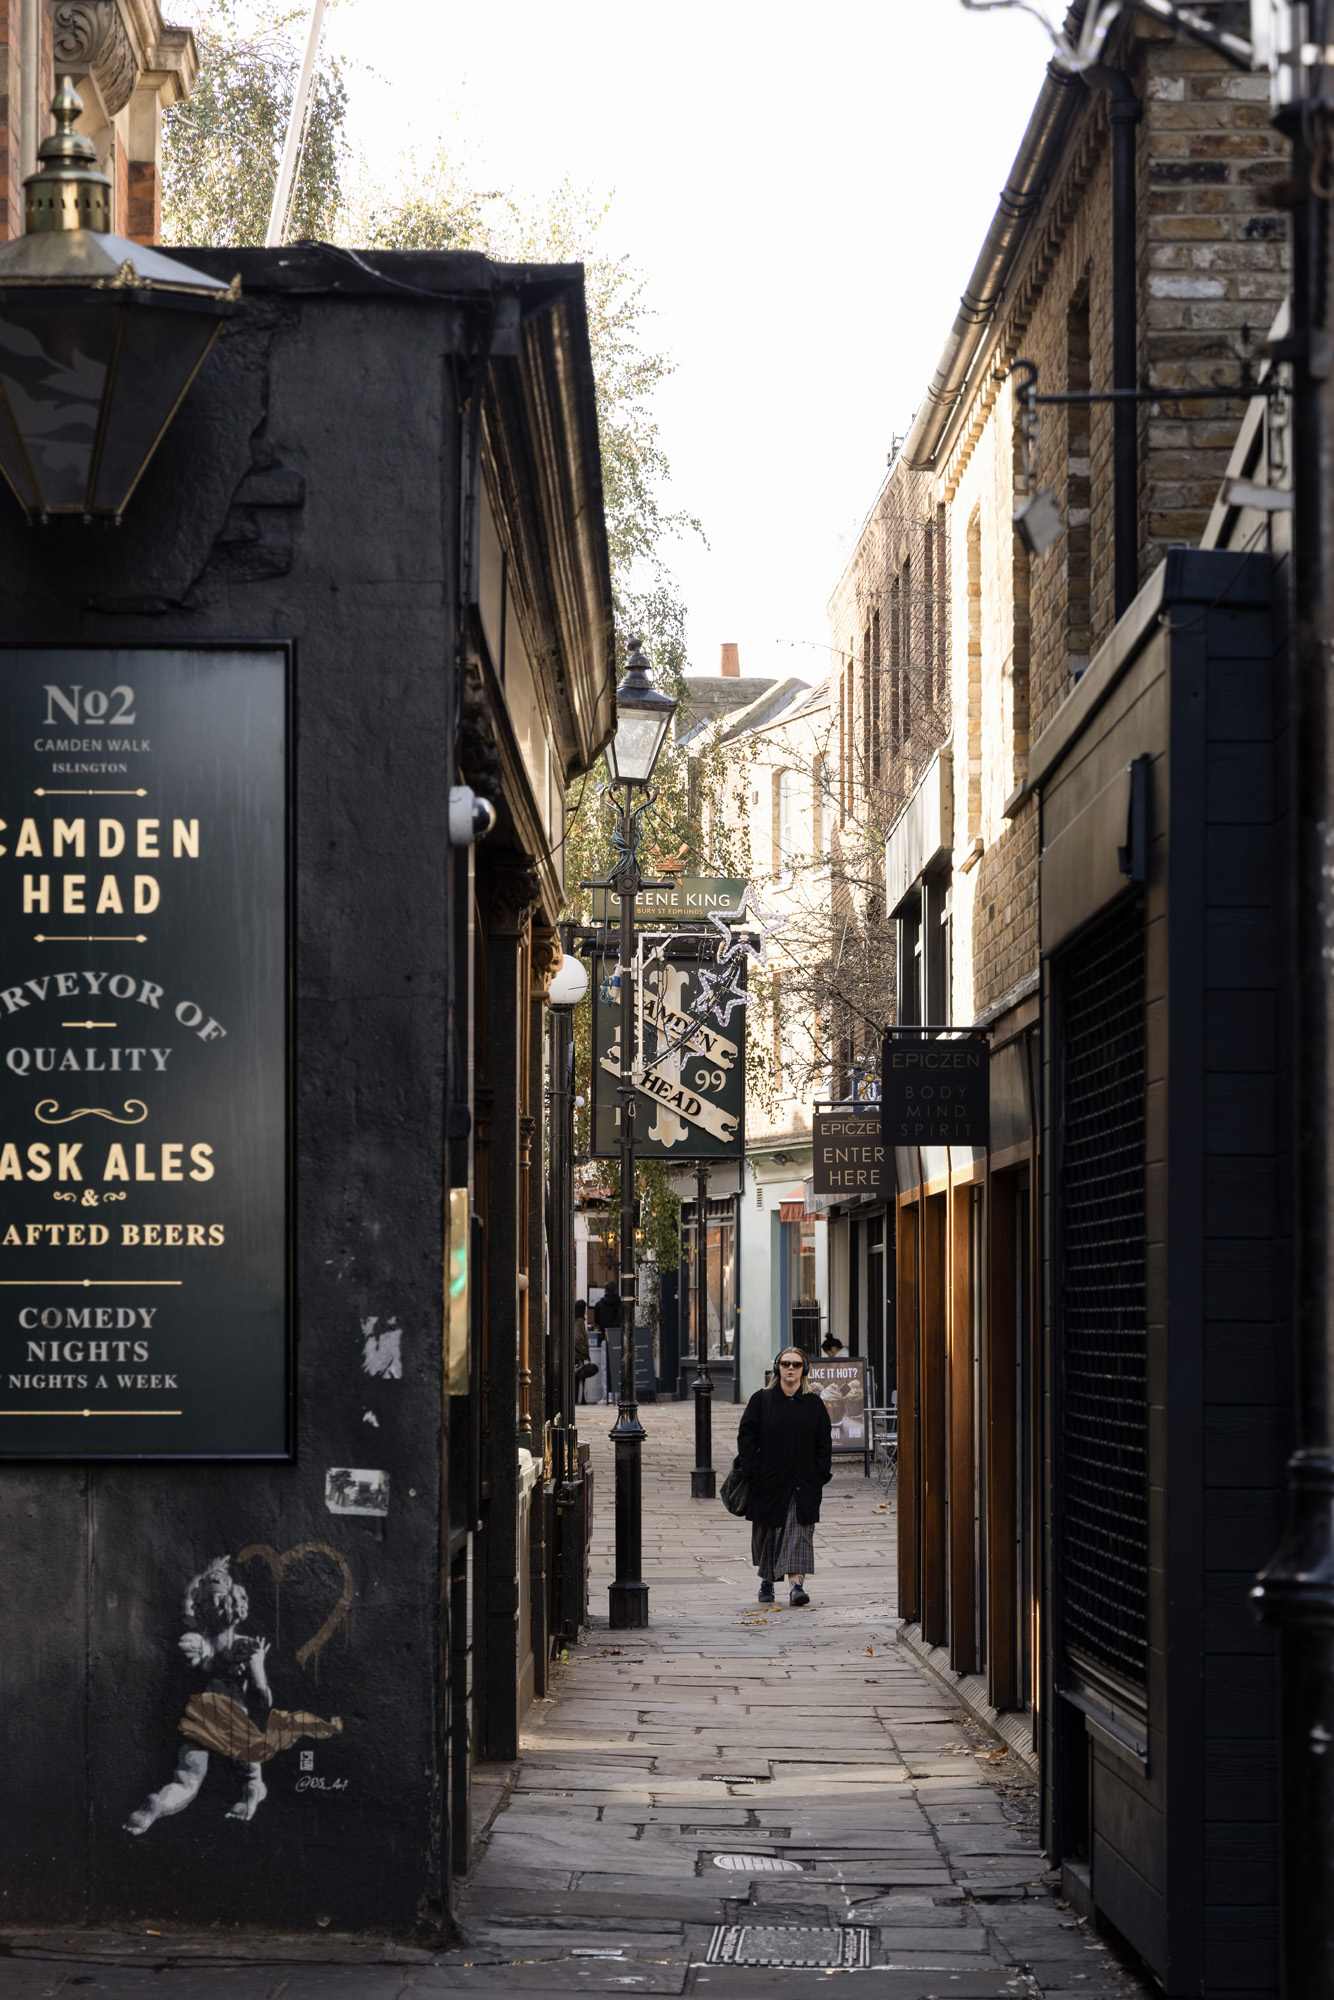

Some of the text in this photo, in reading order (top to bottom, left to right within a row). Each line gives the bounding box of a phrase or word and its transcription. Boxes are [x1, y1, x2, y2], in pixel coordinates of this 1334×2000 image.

[34, 738, 151, 752] CAMDEN WALK
[52, 763, 128, 773] ISLINGTON
[23, 874, 160, 914] HEAD
[611, 892, 730, 907] GEENE KING
[174, 1001, 227, 1042] OF
[6, 1047, 172, 1076] QUALITY
[892, 1053, 980, 1068] EPICZEN
[695, 1069, 726, 1093] 99
[640, 1071, 702, 1116] HEAD
[905, 1086, 968, 1100] BODY
[906, 1105, 966, 1119] MIND
[900, 1123, 972, 1137] SPIRIT
[103, 1143, 215, 1182] ALES
[823, 1147, 885, 1163] ENTER
[829, 1169, 880, 1186] HERE
[81, 1189, 99, 1206] &
[121, 1224, 225, 1246] BEERS
[18, 1308, 157, 1329] COMEDY
[27, 1341, 149, 1362] NIGHTS
[9, 1374, 178, 1389] NIGHTS A WEEK
[808, 1368, 858, 1379] LIKE IT HOT?
